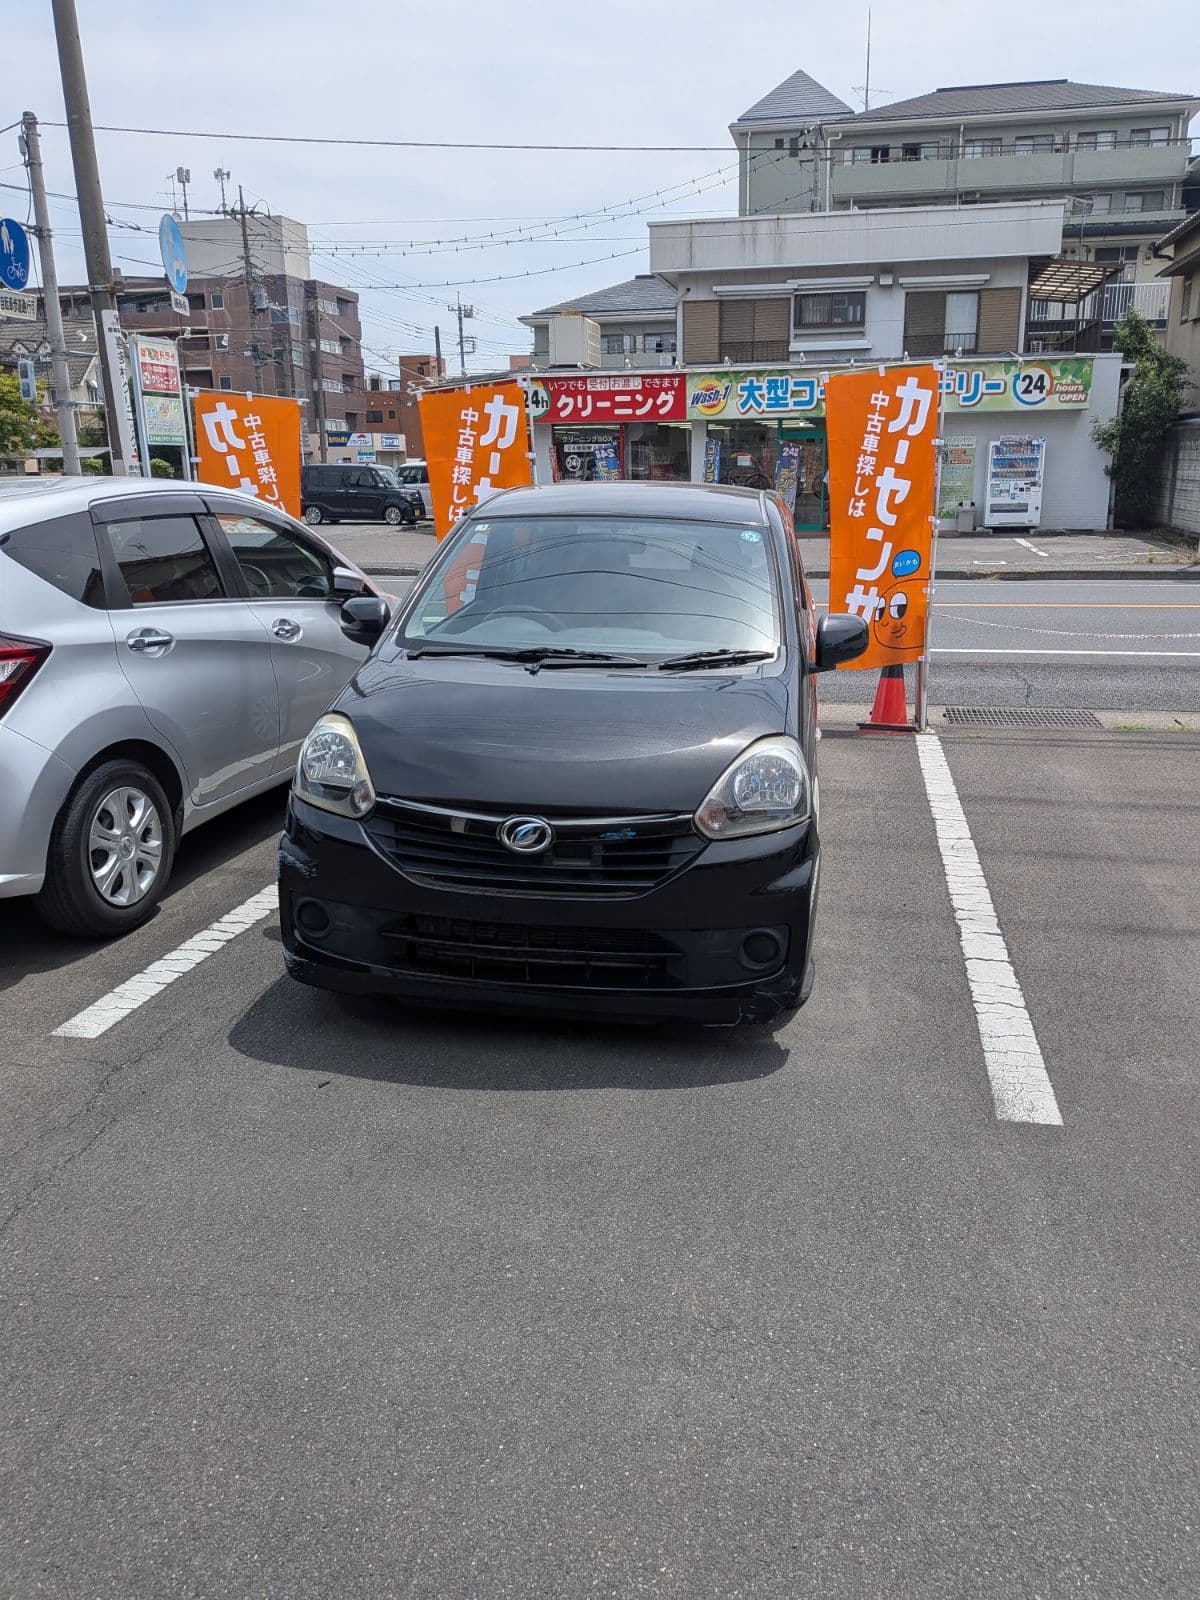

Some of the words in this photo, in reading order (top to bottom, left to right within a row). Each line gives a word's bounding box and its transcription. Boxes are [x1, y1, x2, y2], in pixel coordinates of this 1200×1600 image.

[1021, 374, 1046, 395] 24
[1055, 383, 1084, 392] hours
[556, 390, 676, 418] クリーニング
[690, 384, 732, 408] Wash-1
[1060, 392, 1086, 402] OPEN
[562, 435, 613, 443] クリーニングBOX
[447, 407, 480, 522] 中古車探しは
[847, 390, 890, 518] 中古車探しは
